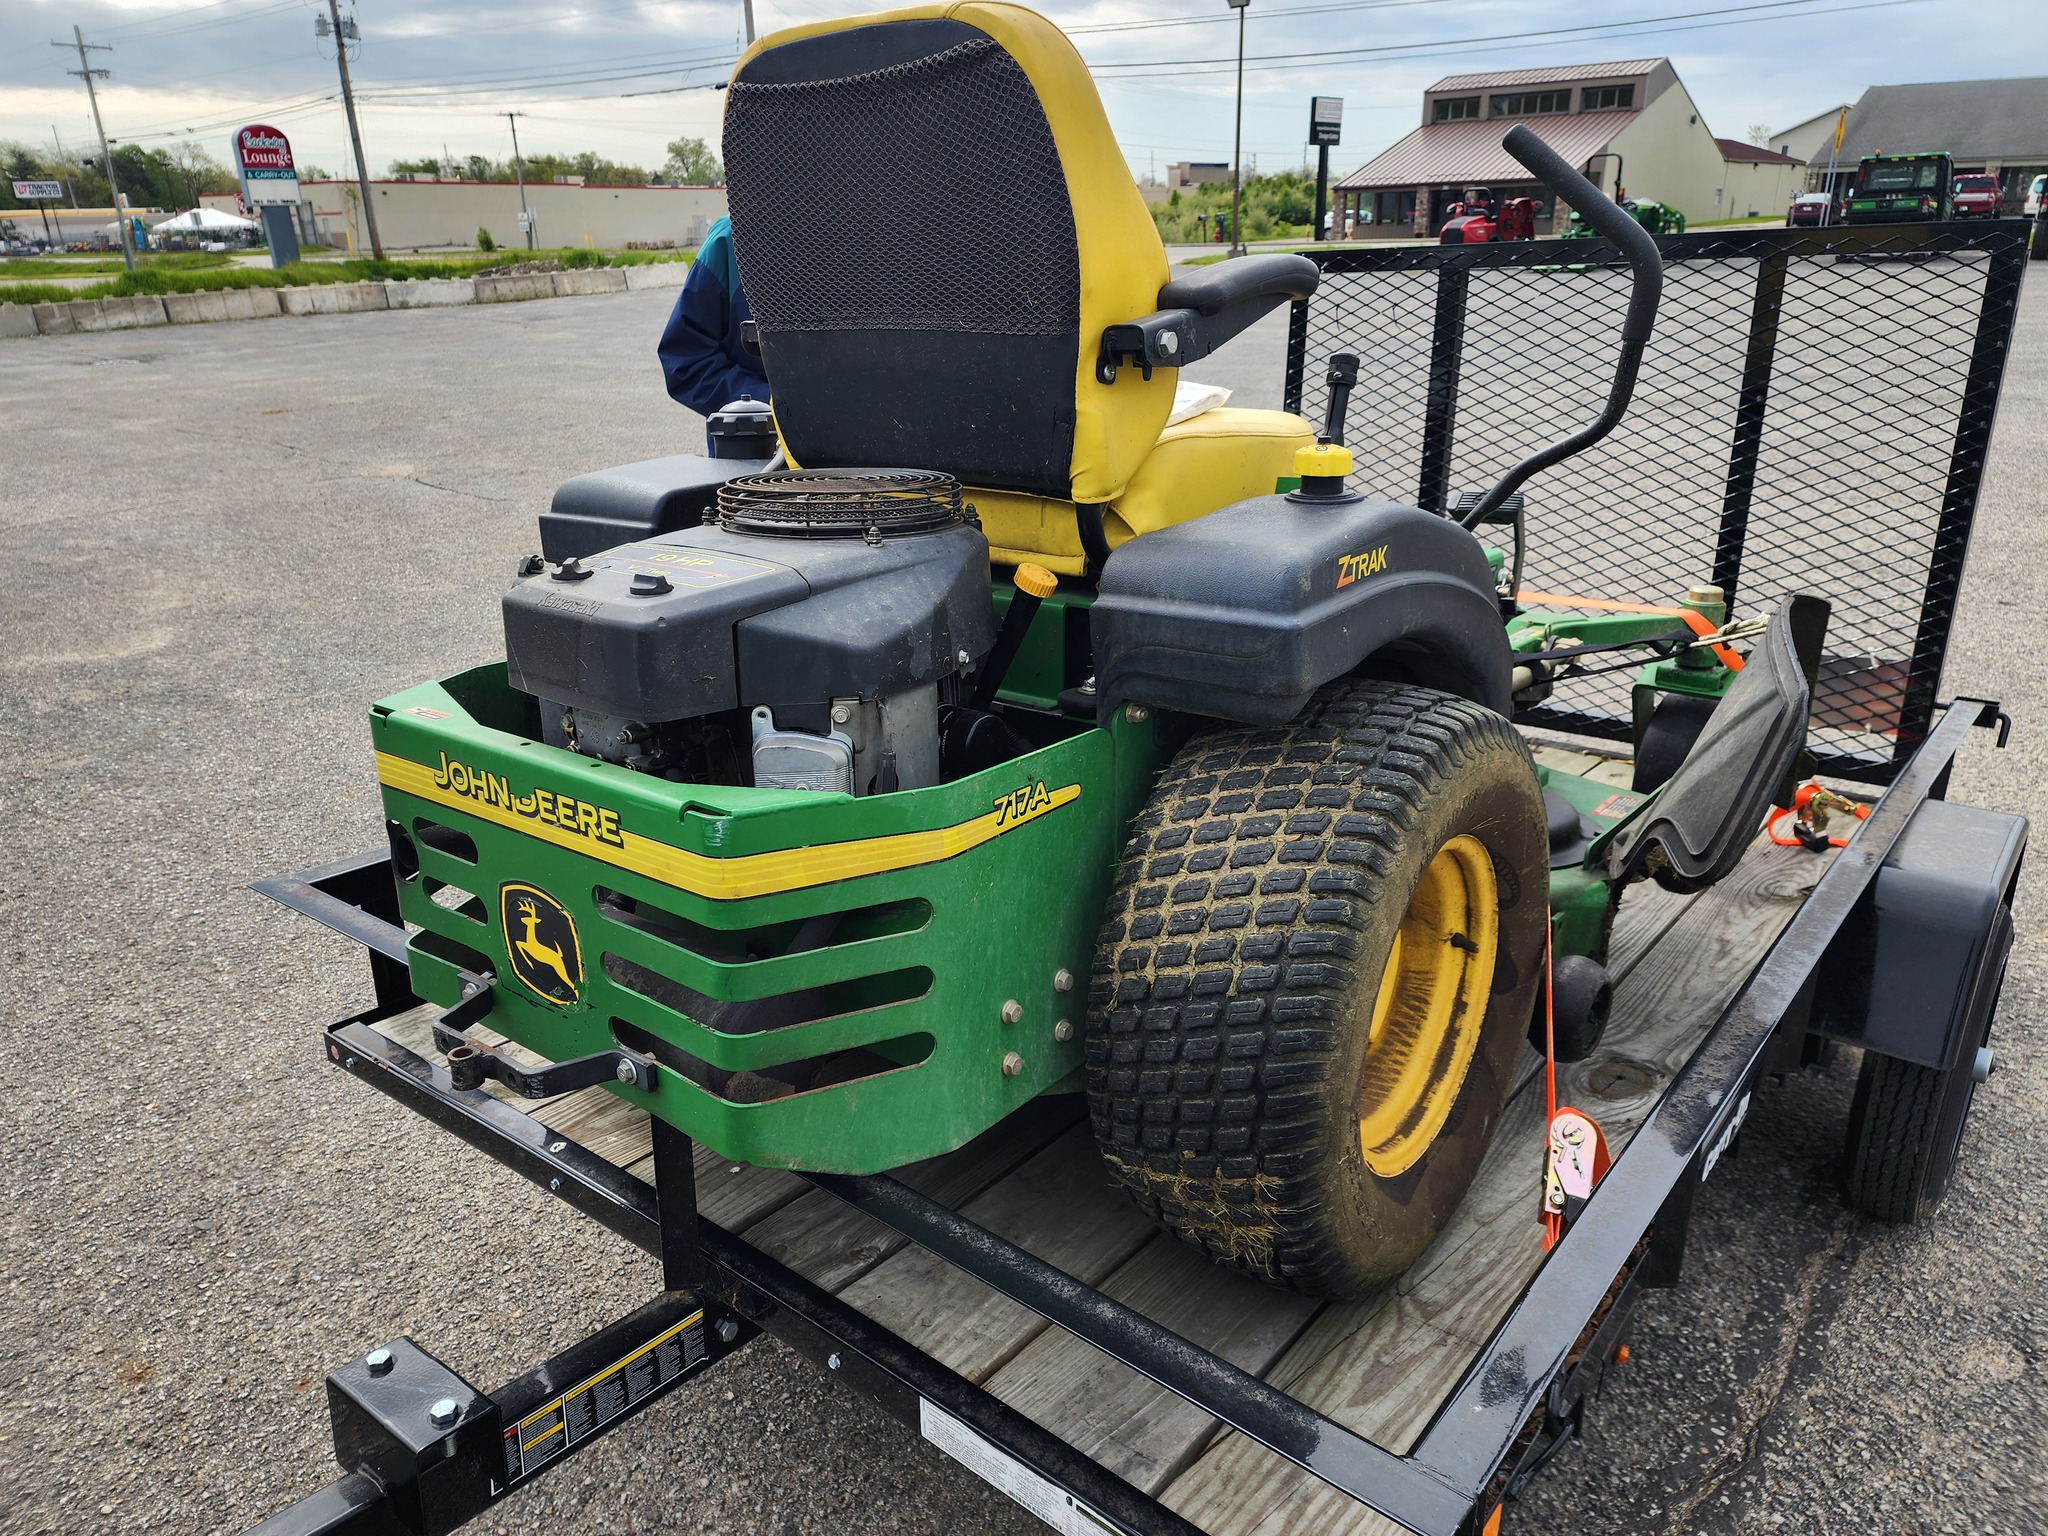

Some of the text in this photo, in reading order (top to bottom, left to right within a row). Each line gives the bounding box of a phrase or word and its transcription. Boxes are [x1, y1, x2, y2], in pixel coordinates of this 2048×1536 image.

[242, 149, 291, 168] Lounge
[648, 553, 714, 566] 19 HP
[535, 592, 603, 617] Kawasaki
[434, 750, 625, 849] JOHN DEERE
[993, 780, 1051, 826] 717A
